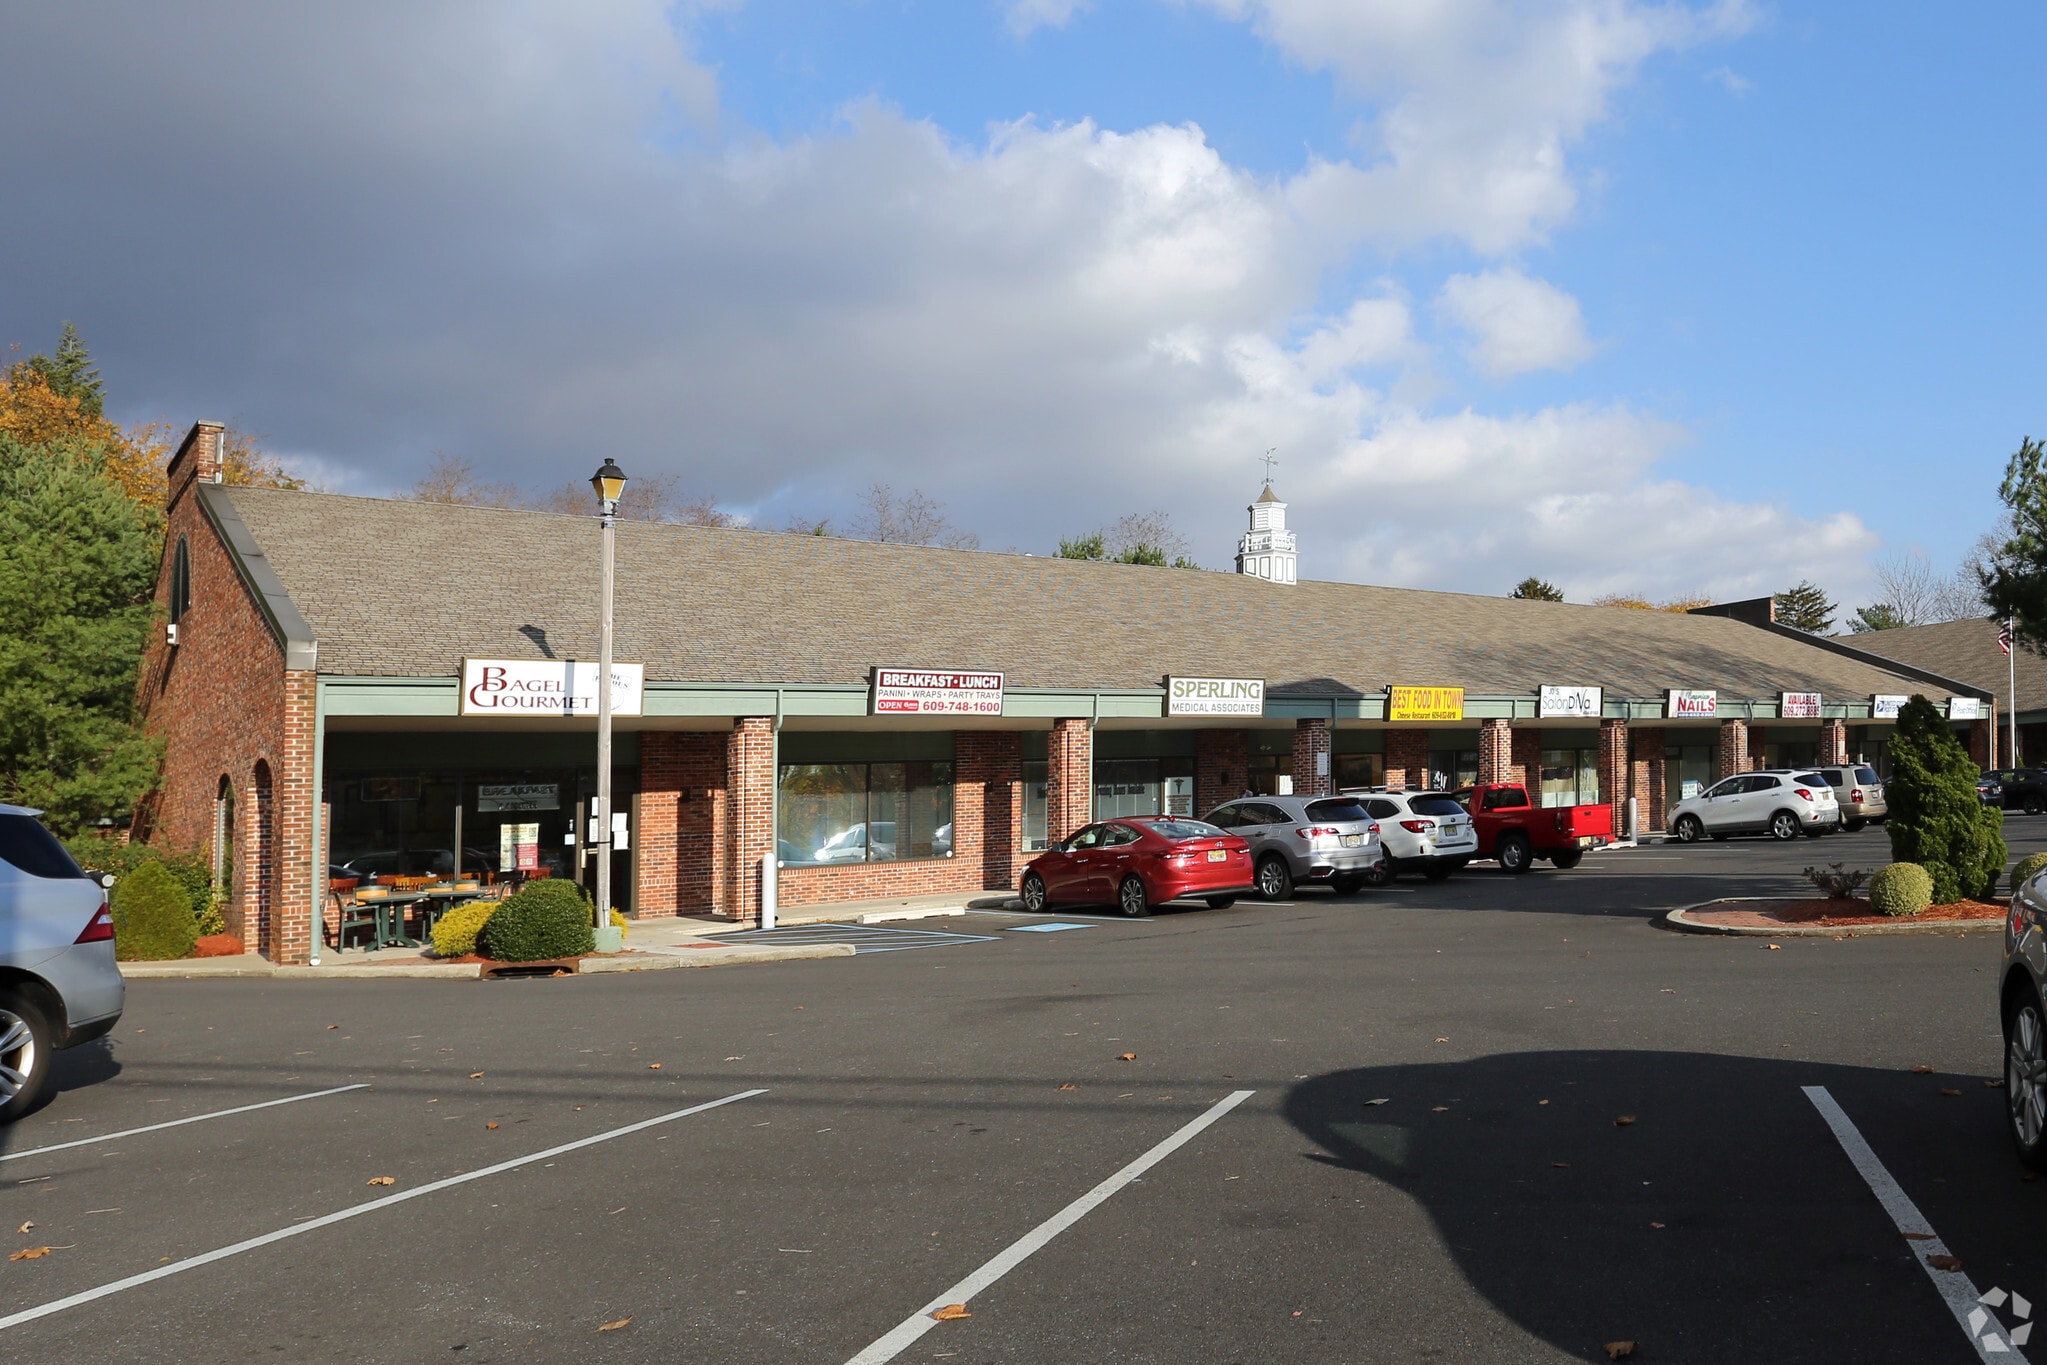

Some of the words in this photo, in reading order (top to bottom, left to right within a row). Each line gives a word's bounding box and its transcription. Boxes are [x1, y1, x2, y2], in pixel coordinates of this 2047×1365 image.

[482, 667, 565, 692] BAGEL
[882, 673, 953, 687] BREAKFAST
[959, 676, 998, 689] LUNCH
[469, 683, 593, 709] GOURMET
[878, 689, 906, 697] PANINI
[912, 690, 942, 698] WRAPS
[948, 691, 974, 699] PARTY
[976, 691, 1000, 699] TRAYS
[1173, 680, 1260, 699] SPERLING
[878, 701, 902, 710] OPEN
[1392, 689, 1411, 709] BEST
[1413, 689, 1431, 709] FOOD
[1434, 689, 1441, 710] IN
[1443, 690, 1463, 710] TOWN
[1677, 696, 1715, 712] NAILS
[1788, 694, 1816, 705] AVAILABLE
[923, 701, 1000, 712] 609-748-1600
[1171, 702, 1209, 712] MEDICAL
[1211, 703, 1260, 713] ASSOCIATES
[1397, 711, 1411, 719] Chinese
[1412, 711, 1430, 719] Restaurant
